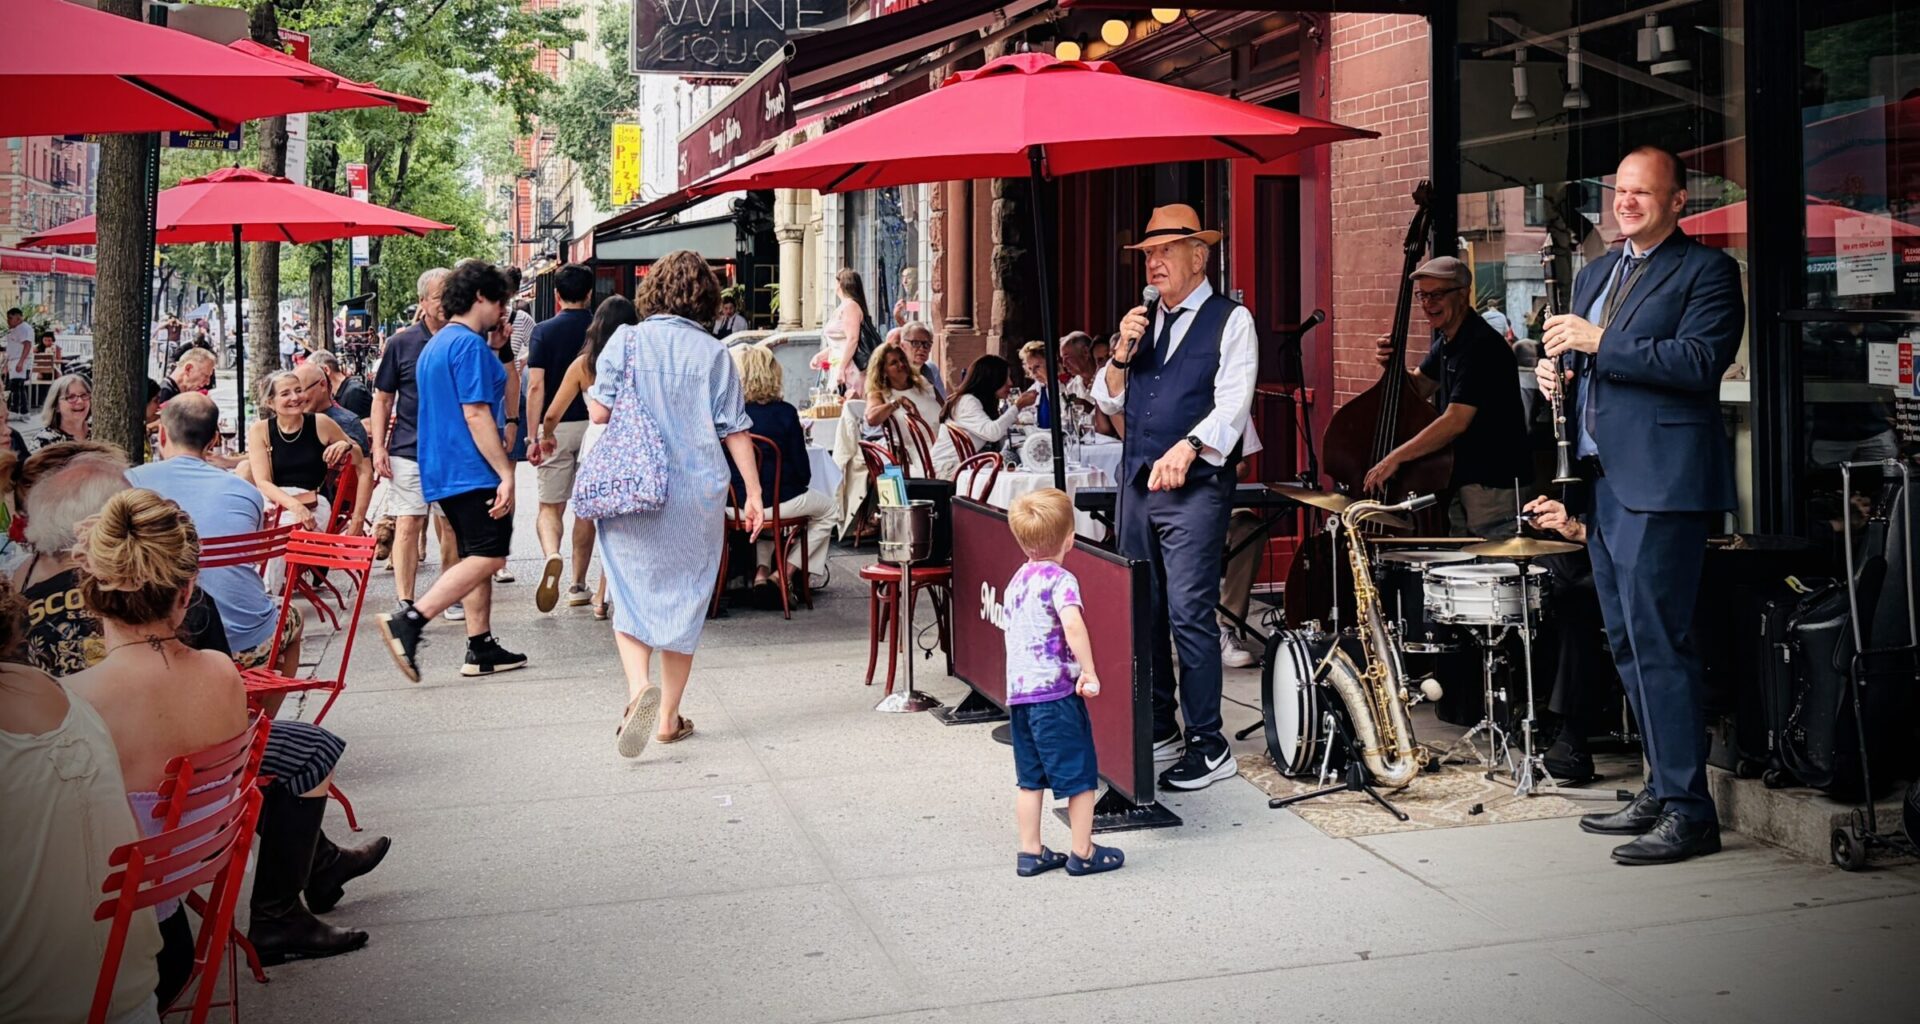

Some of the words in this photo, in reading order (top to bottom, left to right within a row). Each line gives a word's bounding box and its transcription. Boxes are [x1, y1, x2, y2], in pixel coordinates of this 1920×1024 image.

[664, 0, 826, 31] WINE
[577, 477, 643, 501] LIBERTY
[28, 588, 85, 627] SCO
[66, 611, 77, 620] &
